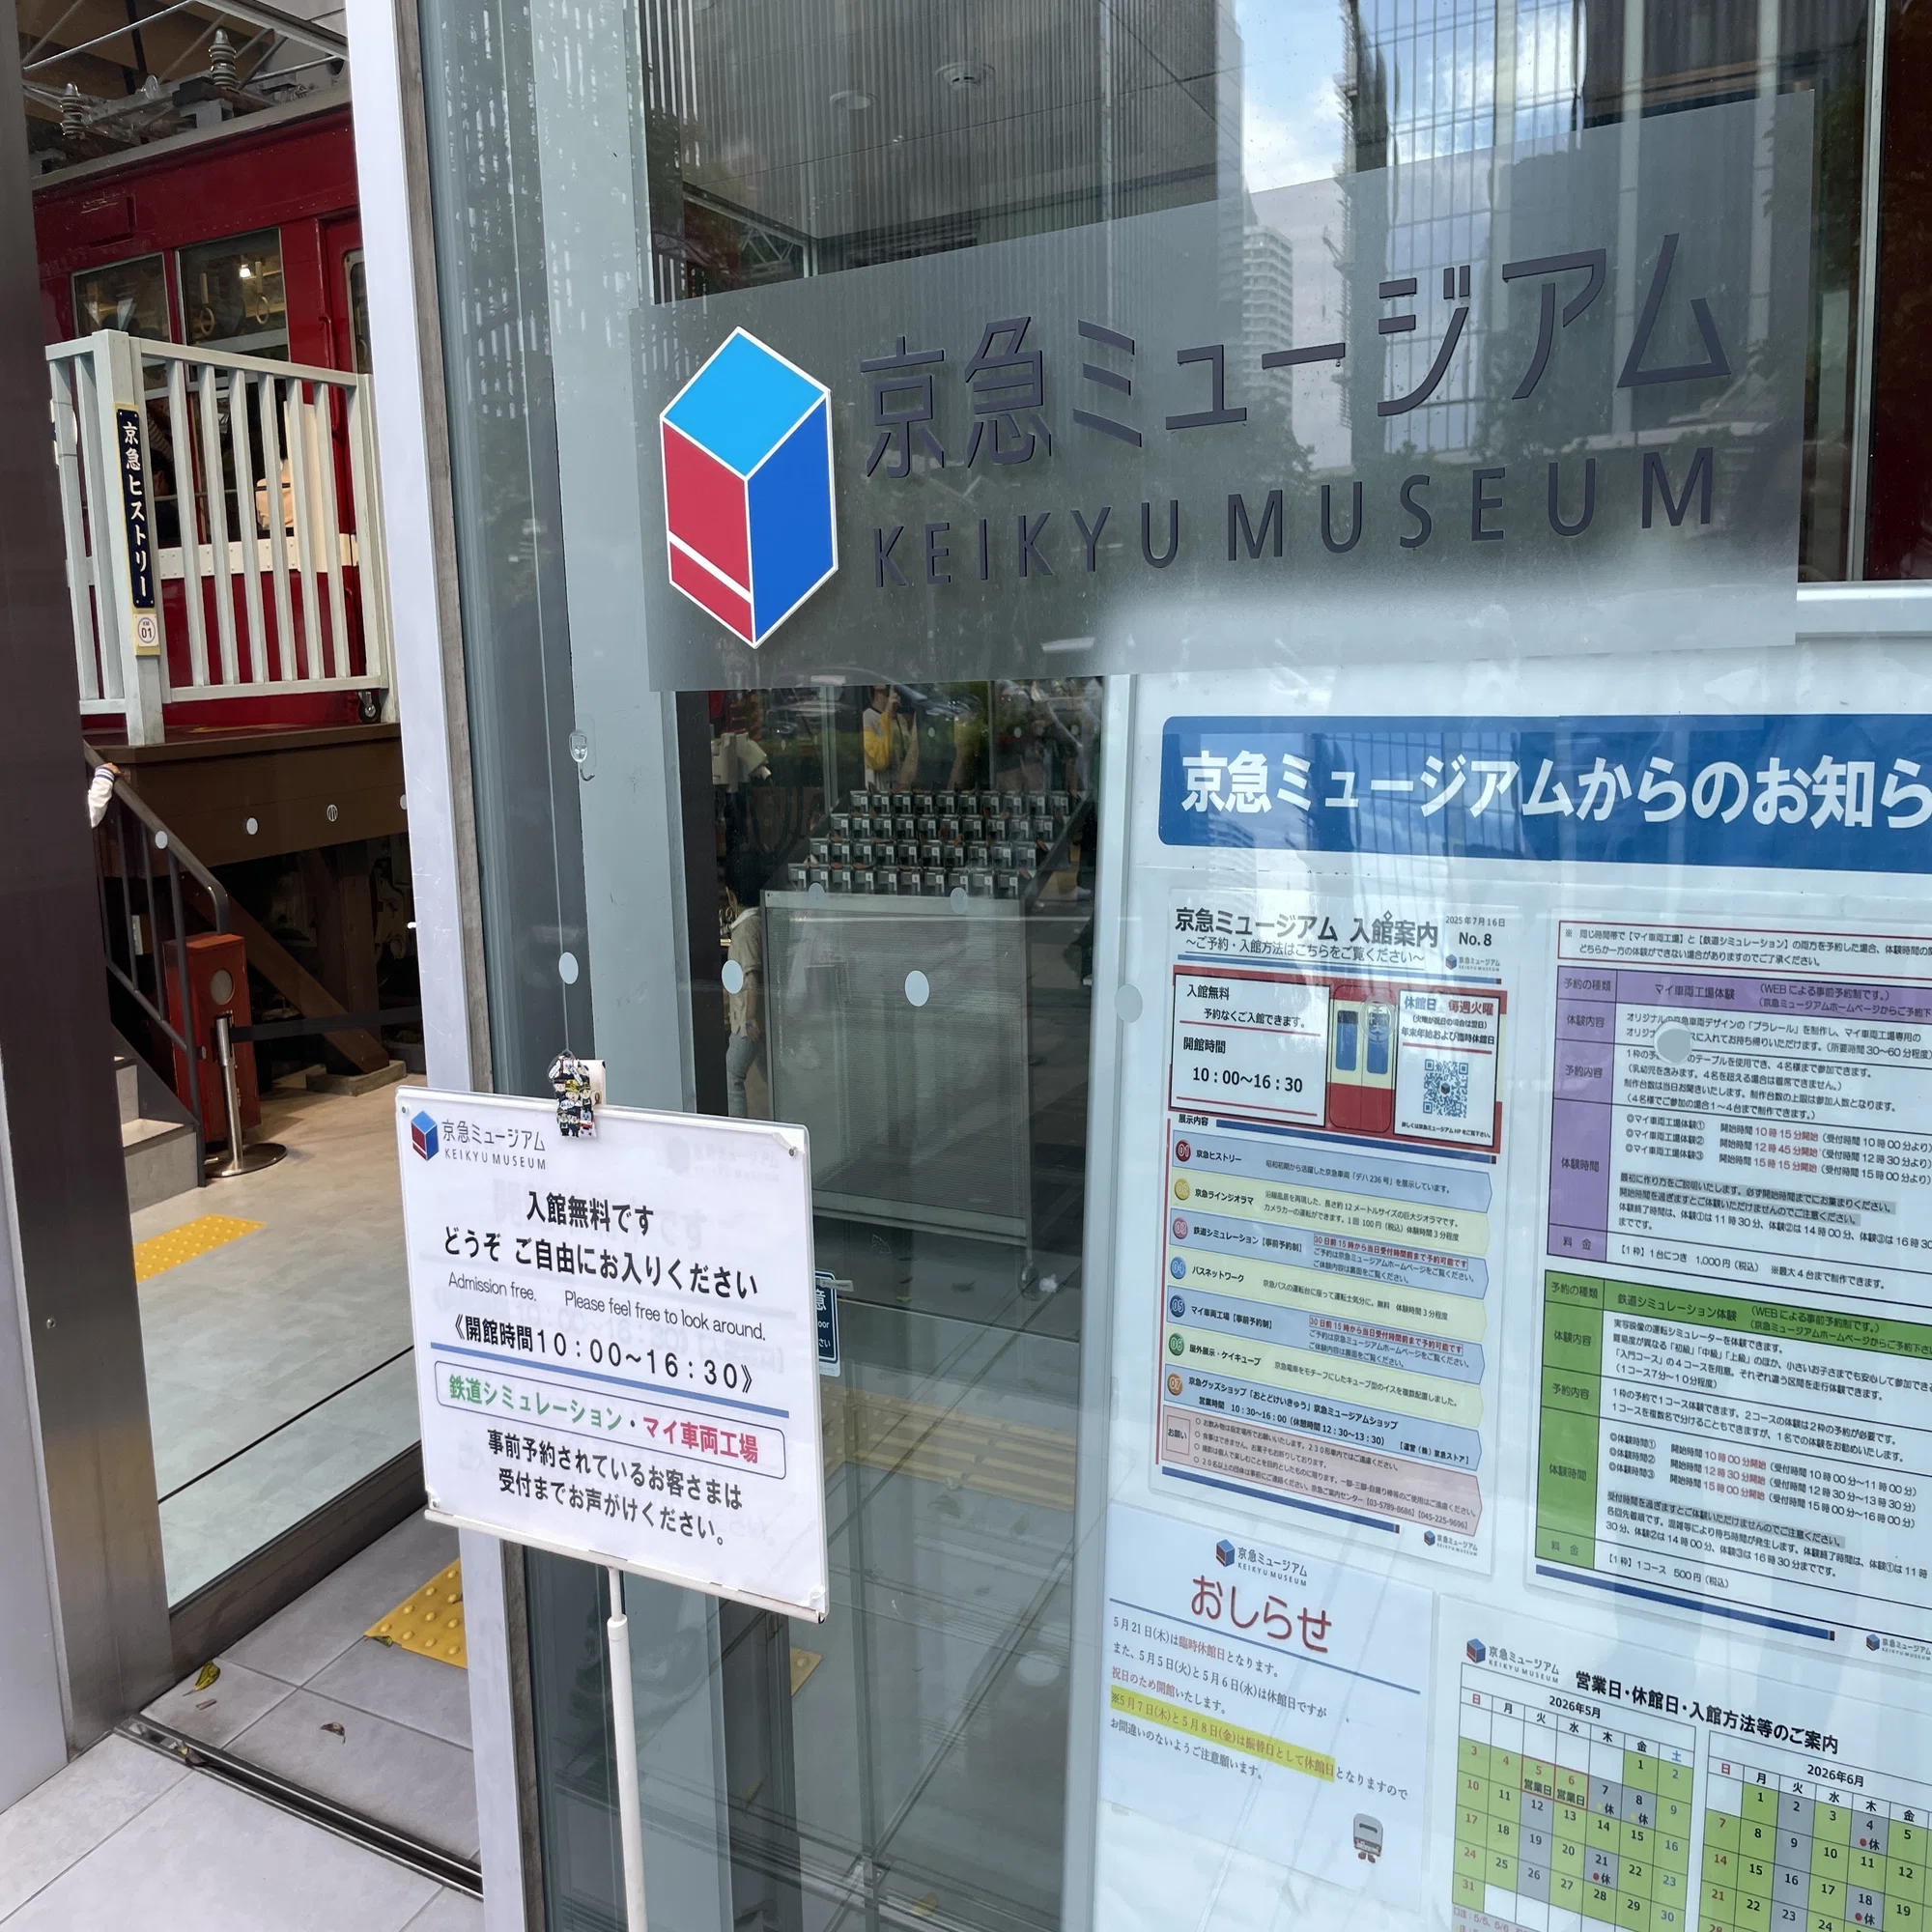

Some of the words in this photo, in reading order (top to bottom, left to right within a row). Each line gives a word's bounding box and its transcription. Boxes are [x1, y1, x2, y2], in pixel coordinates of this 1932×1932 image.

[861, 234, 1732, 477] 京急ミュージアム
[122, 421, 150, 597] 京急ヒストリー
[874, 499, 1179, 588] KEIKYU
[1228, 447, 1714, 561] MUSEUM
[141, 627, 153, 639] 01
[1181, 750, 1932, 830] 京急ミュージアムからのお知ら
[1175, 907, 1338, 941] 京急ミュージアム
[1350, 917, 1438, 949] 入館案内
[1186, 984, 1230, 1001] 入館無料
[1563, 978, 1611, 992] 予約の種類
[1655, 983, 1735, 1001] マイ車両工場体験
[1405, 996, 1436, 1010] 休館日
[1449, 1000, 1493, 1015] 毎週火曜
[1204, 1008, 1305, 1029] 予約なくご入館できます。
[1566, 1014, 1605, 1029] 体験内容
[1182, 1037, 1226, 1055] 開館時間
[1401, 1027, 1495, 1044] 年末年始および臨時休館日
[1565, 1065, 1603, 1078] 予約内容
[1179, 1114, 1208, 1126] 展示内容
[441, 1119, 546, 1152] 京急ミュージアム
[444, 1148, 489, 1164] KEIKYU
[492, 1152, 547, 1171] MUSEUM
[1196, 1149, 1241, 1163] 京急ヒストリー
[1561, 1157, 1600, 1172] 体験時間
[1195, 1188, 1254, 1206] 京急ラインジオラマ
[526, 1190, 655, 1236] 入館無料です
[443, 1225, 501, 1263] どうぞ
[515, 1236, 759, 1299] ご自由にお入りください
[1551, 1281, 1599, 1299] 予約の種類
[448, 1271, 509, 1297] Admission
[510, 1280, 537, 1302] free.
[564, 1289, 606, 1313] Please
[609, 1297, 633, 1318] feel
[635, 1301, 662, 1322] free
[664, 1307, 678, 1325] to
[680, 1308, 710, 1331] look
[713, 1319, 766, 1341] around.
[1617, 1293, 1737, 1322] 鉄道シミュレーション体験
[1553, 1329, 1592, 1347] 体験内容
[1199, 1396, 1225, 1410] 営業時間
[1551, 1382, 1590, 1400] 予約内容
[449, 1374, 759, 1465] 鉄道シミュレーション・マイ車両工場
[1168, 1428, 1187, 1439] お願い
[487, 1428, 743, 1511] 事前予約されているお客さまは
[1548, 1463, 1587, 1481] 体験時間
[498, 1467, 724, 1546] 受付までお声がけください。
[1236, 1546, 1308, 1577] 京急ミュージアム
[1237, 1562, 1268, 1577] KEIKYU
[1270, 1571, 1307, 1586] MUSEUM
[1191, 1574, 1332, 1653] おしらせ
[1489, 1645, 1560, 1675] 京急ミュージアム
[1489, 1660, 1520, 1673] KEIKYU
[1521, 1667, 1559, 1684] MUSEUM
[1112, 1665, 1226, 1715] 祝日のため開館いたします。
[1548, 1695, 1602, 1719] 2026年5月
[1472, 1693, 1481, 1705] 日
[1503, 1703, 1513, 1715] 月
[1536, 1713, 1547, 1723] 火
[1569, 1722, 1579, 1733] 水
[1603, 1732, 1612, 1743] 木
[1636, 1741, 1647, 1752] 金
[1671, 1750, 1682, 1763] 土
[1111, 1718, 1262, 1779] お間違いのないようご注意願います。
[1471, 1746, 1477, 1755] 3
[1503, 1756, 1509, 1766] 4
[1536, 1766, 1542, 1775] 5
[1569, 1776, 1575, 1785] 6
[1603, 1785, 1608, 1795] 7
[1635, 1795, 1642, 1804] 8
[1670, 1805, 1677, 1815] 9
[1638, 1760, 1643, 1769] 1
[1672, 1770, 1679, 1779] 2
[1807, 1764, 1863, 1787] 2026年6月
[1524, 1778, 1552, 1796] 営業日
[1557, 1788, 1585, 1805] 営業日
[1605, 1803, 1614, 1815] 休
[1638, 1813, 1649, 1825] 休
[1721, 1763, 1730, 1775] 日
[1756, 1773, 1767, 1785] 月
[1793, 1782, 1804, 1794] 火
[1829, 1791, 1840, 1803] 水
[1865, 1801, 1877, 1812] 木
[1904, 1810, 1915, 1822] 金
[1467, 1780, 1479, 1790] 10
[1499, 1789, 1511, 1801] 11
[1531, 1800, 1544, 1811] 12
[1564, 1810, 1577, 1821] 13
[1597, 1820, 1610, 1832] 14
[1631, 1830, 1644, 1841] 15
[1665, 1840, 1678, 1851] 16
[1757, 1792, 1764, 1803] 1
[1793, 1802, 1800, 1811] 2
[1830, 1810, 1836, 1821] 3
[1866, 1820, 1873, 1830] 4
[1904, 1830, 1911, 1839] 5
[1466, 1814, 1478, 1825] 17
[1497, 1824, 1510, 1835] 18
[1530, 1833, 1543, 1845] 19
[1562, 1844, 1575, 1856] 20
[1595, 1854, 1608, 1866] 21
[1629, 1864, 1642, 1876] 22
[1662, 1875, 1676, 1887] 23
[1719, 1818, 1726, 1828] 7
[1754, 1829, 1762, 1838] 8
[1791, 1837, 1798, 1847] 9
[1824, 1847, 1837, 1859] 10
[1861, 1857, 1874, 1867] 11
[1898, 1867, 1913, 1879] 12
[1869, 1838, 1880, 1850] 休
[1463, 1847, 1477, 1859] 24
[1495, 1858, 1509, 1869] 25
[1527, 1867, 1541, 1880] 26
[1561, 1879, 1574, 1889] 27
[1594, 1889, 1606, 1901] 28
[1627, 1899, 1640, 1911] 29
[1661, 1910, 1674, 1921] 30
[1463, 1879, 1475, 1890] 31
[1602, 1873, 1611, 1885] 休
